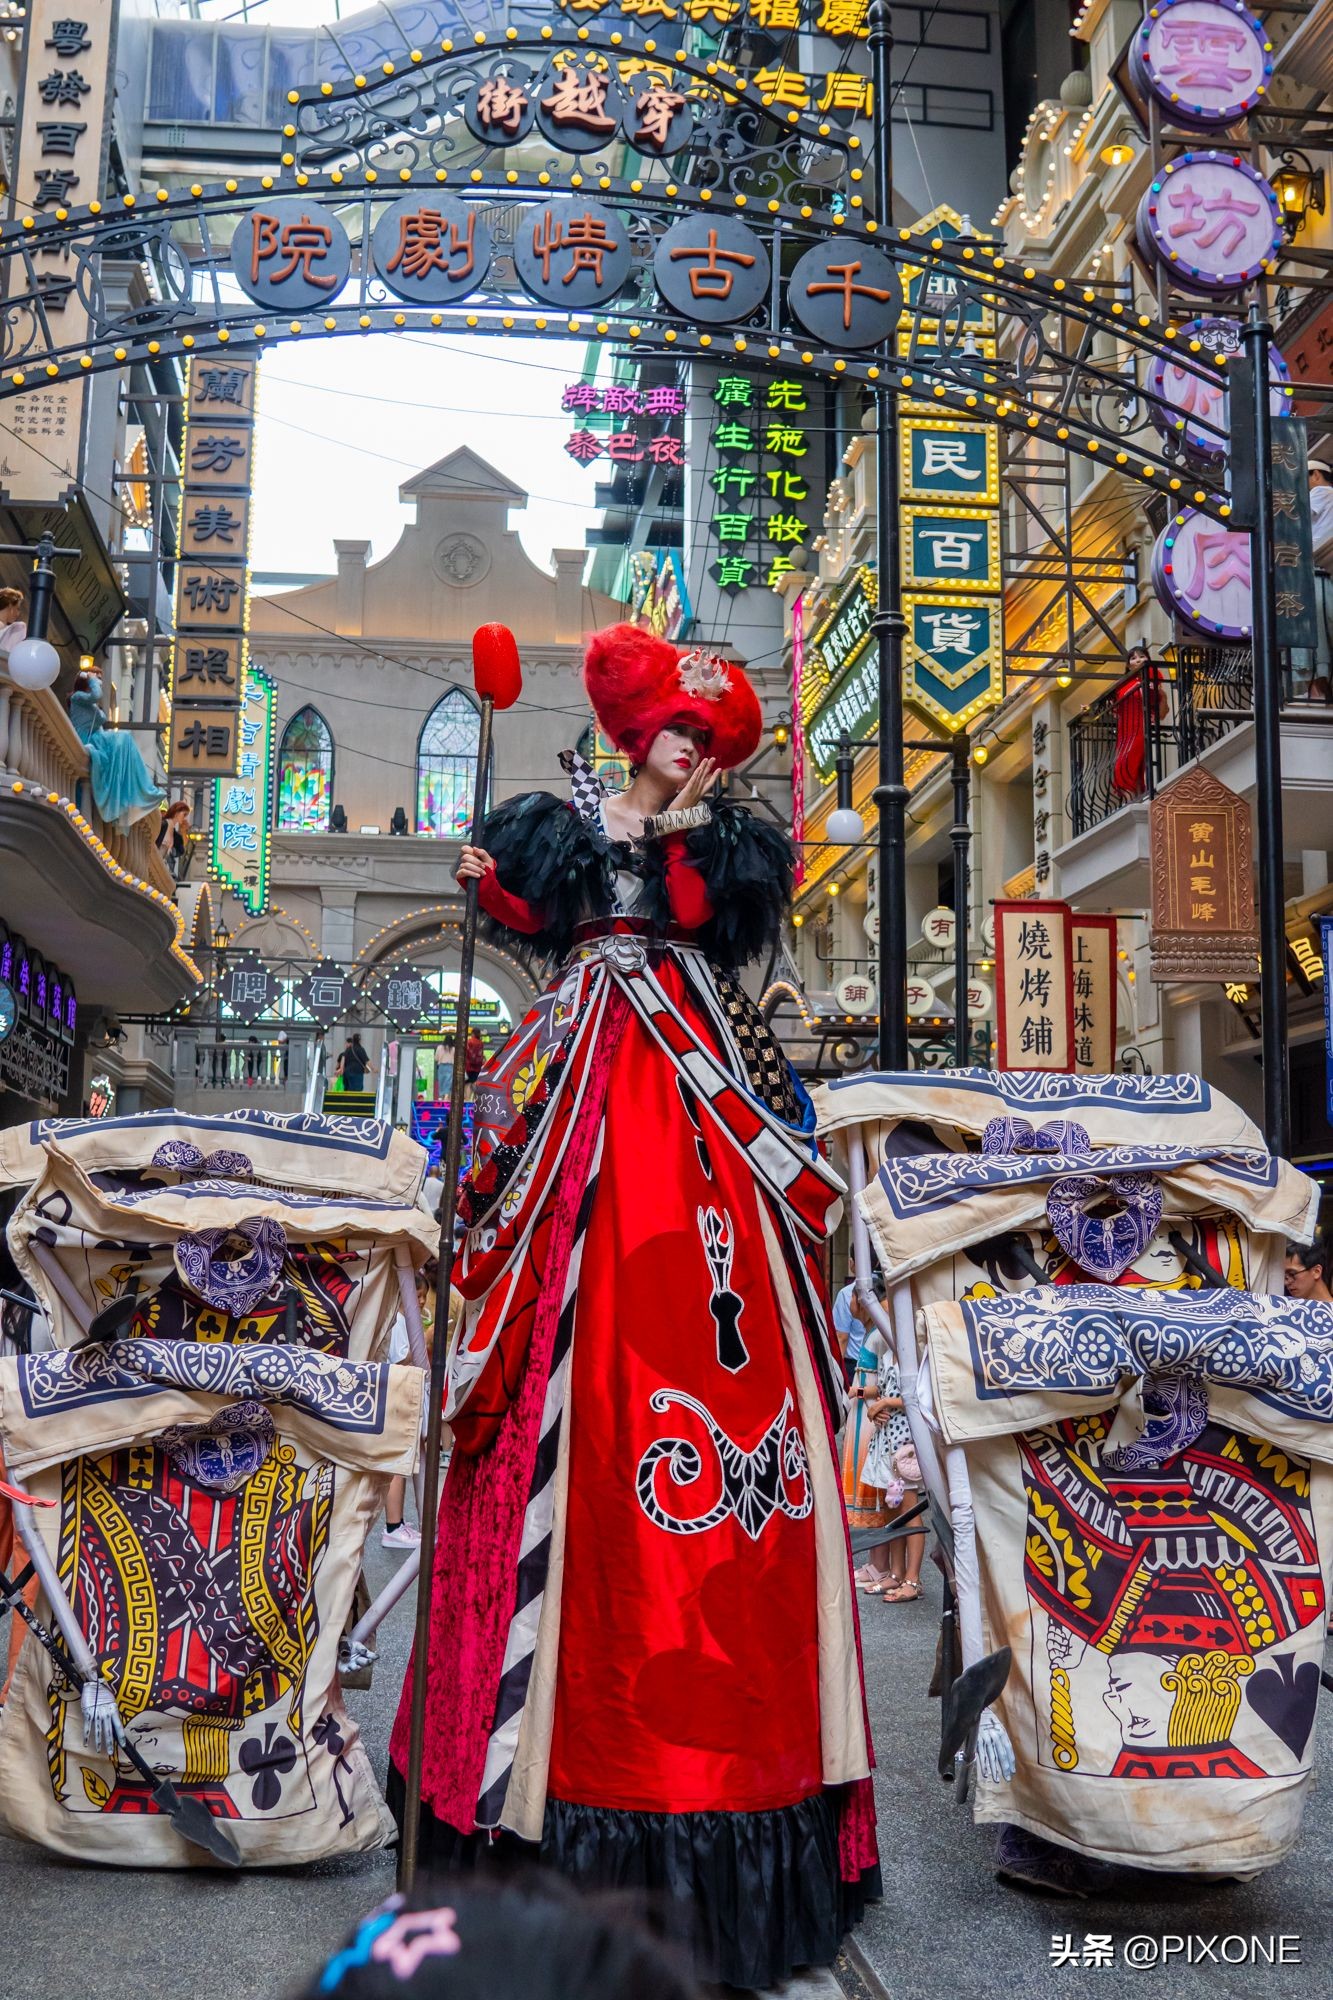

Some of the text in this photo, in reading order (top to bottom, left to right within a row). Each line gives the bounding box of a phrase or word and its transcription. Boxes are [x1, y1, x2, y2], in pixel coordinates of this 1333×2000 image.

[177, 368, 247, 757] 蘭芳美術照相
